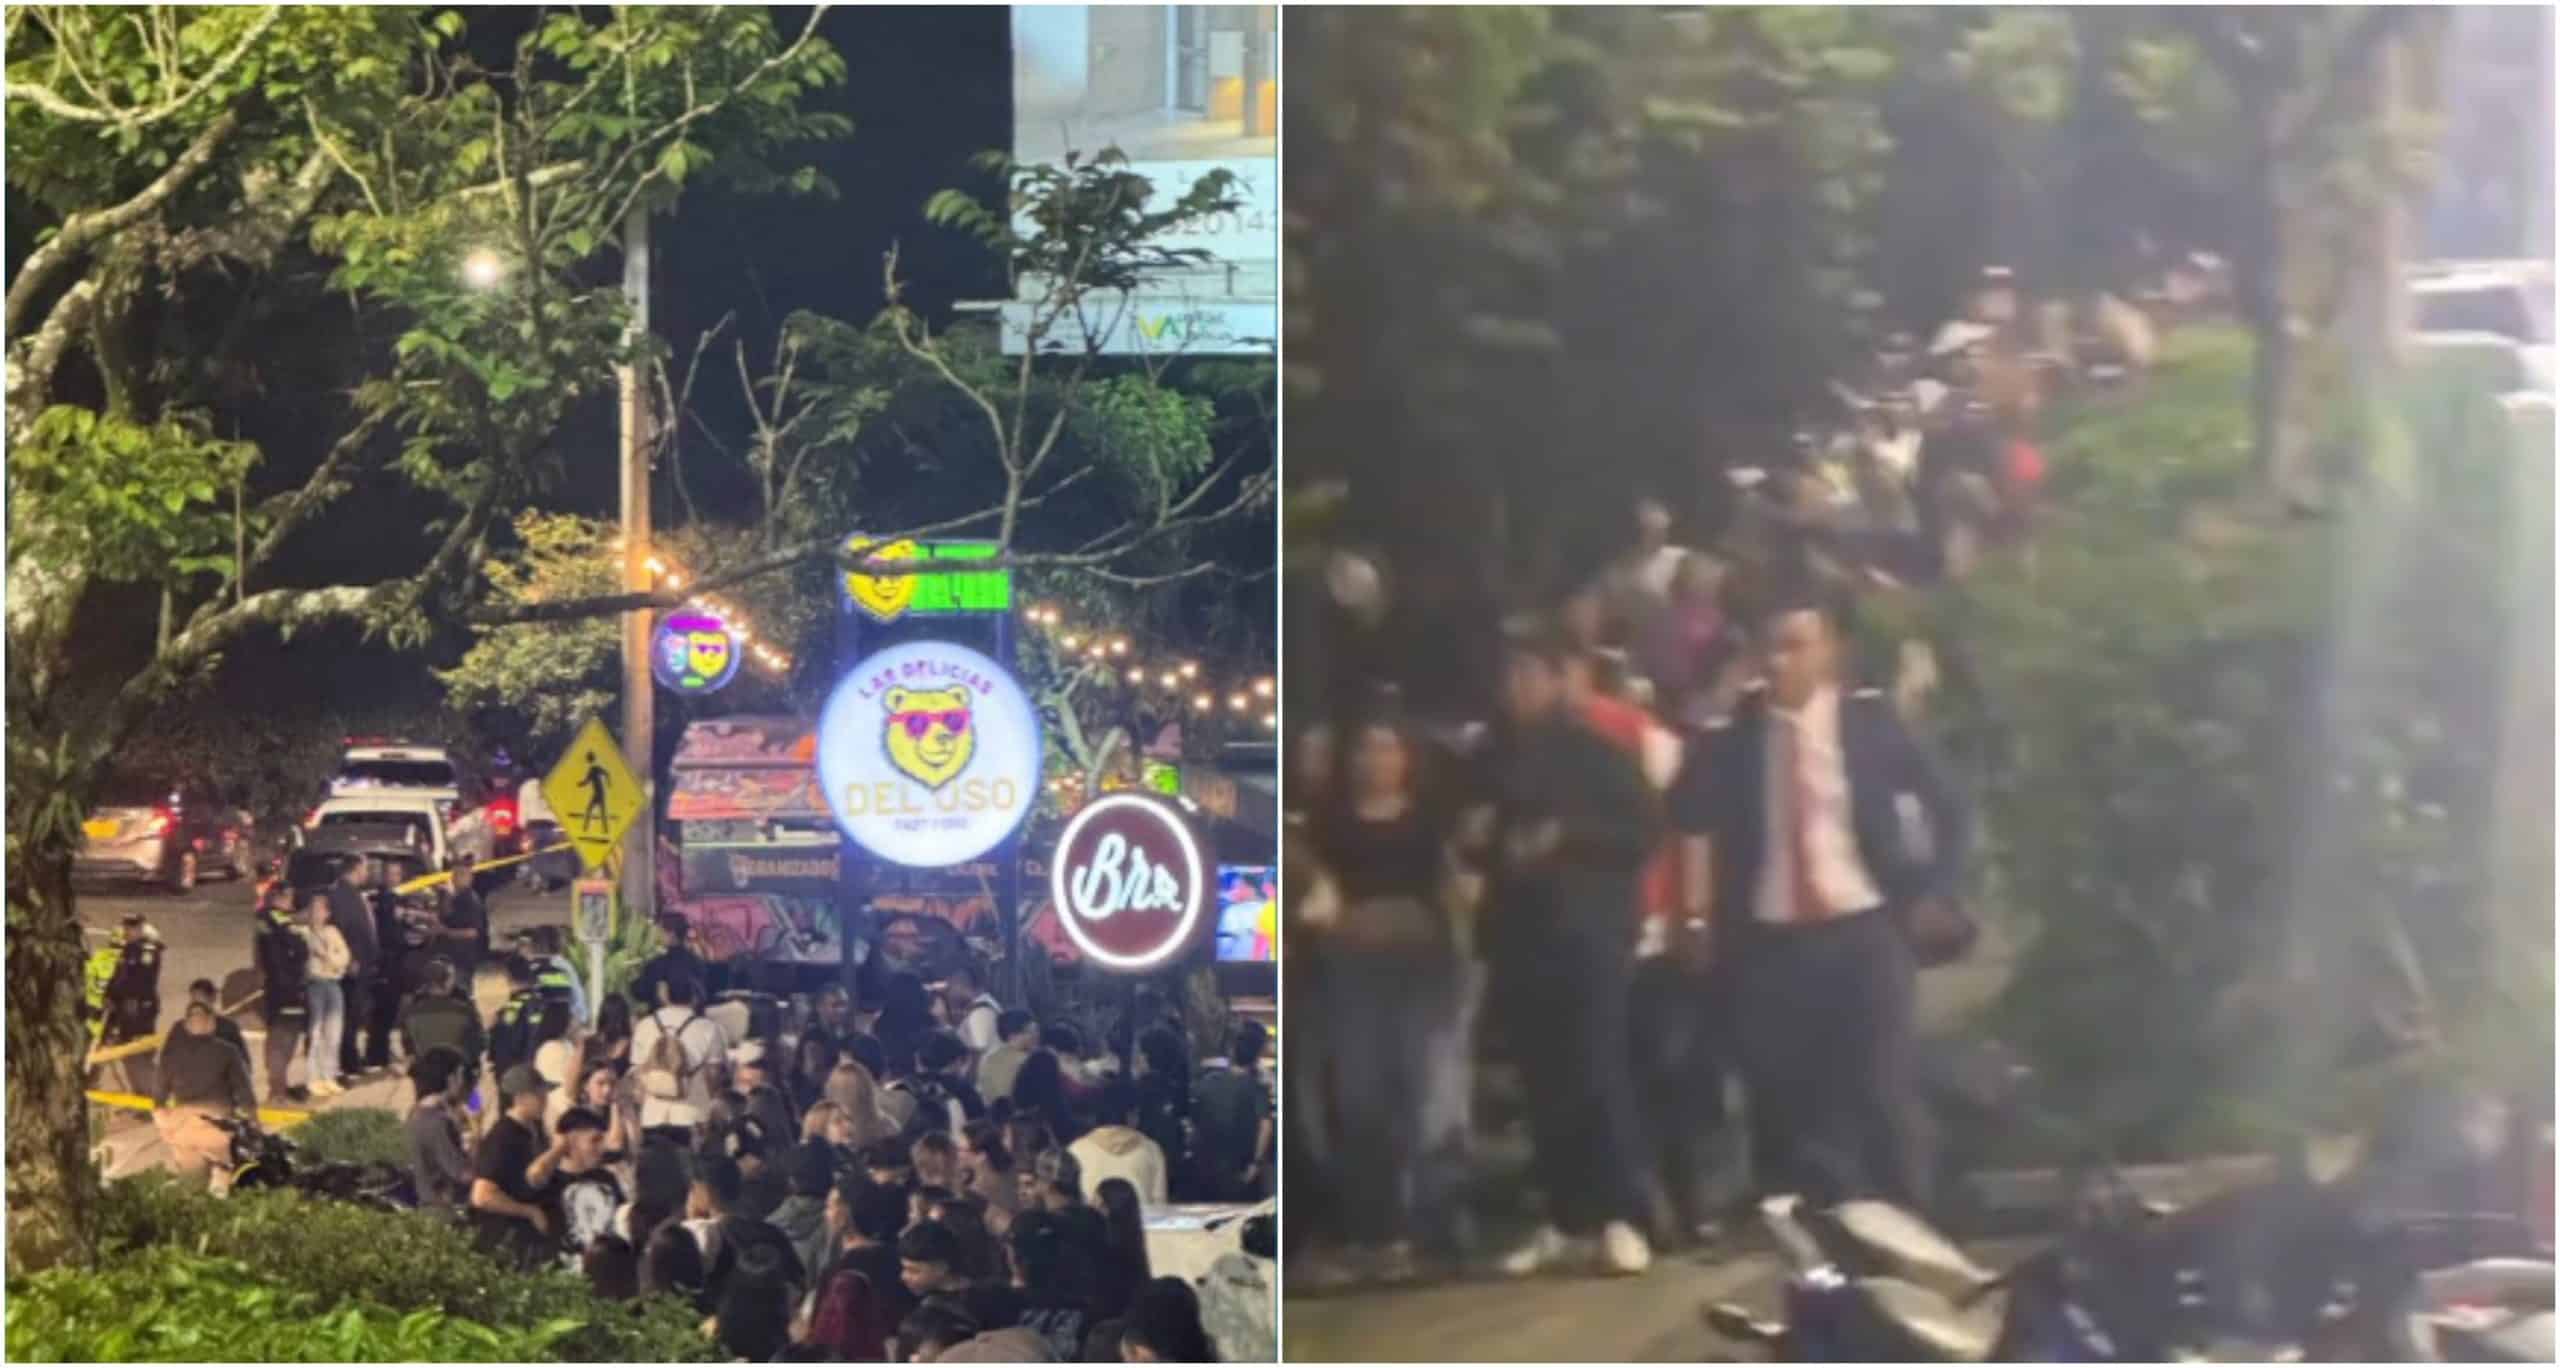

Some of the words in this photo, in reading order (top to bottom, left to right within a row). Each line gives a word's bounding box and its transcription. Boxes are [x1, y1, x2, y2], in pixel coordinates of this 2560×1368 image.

[857, 668, 896, 700] LAS
[903, 660, 994, 695] DELICIAS
[846, 781, 923, 817] DEL
